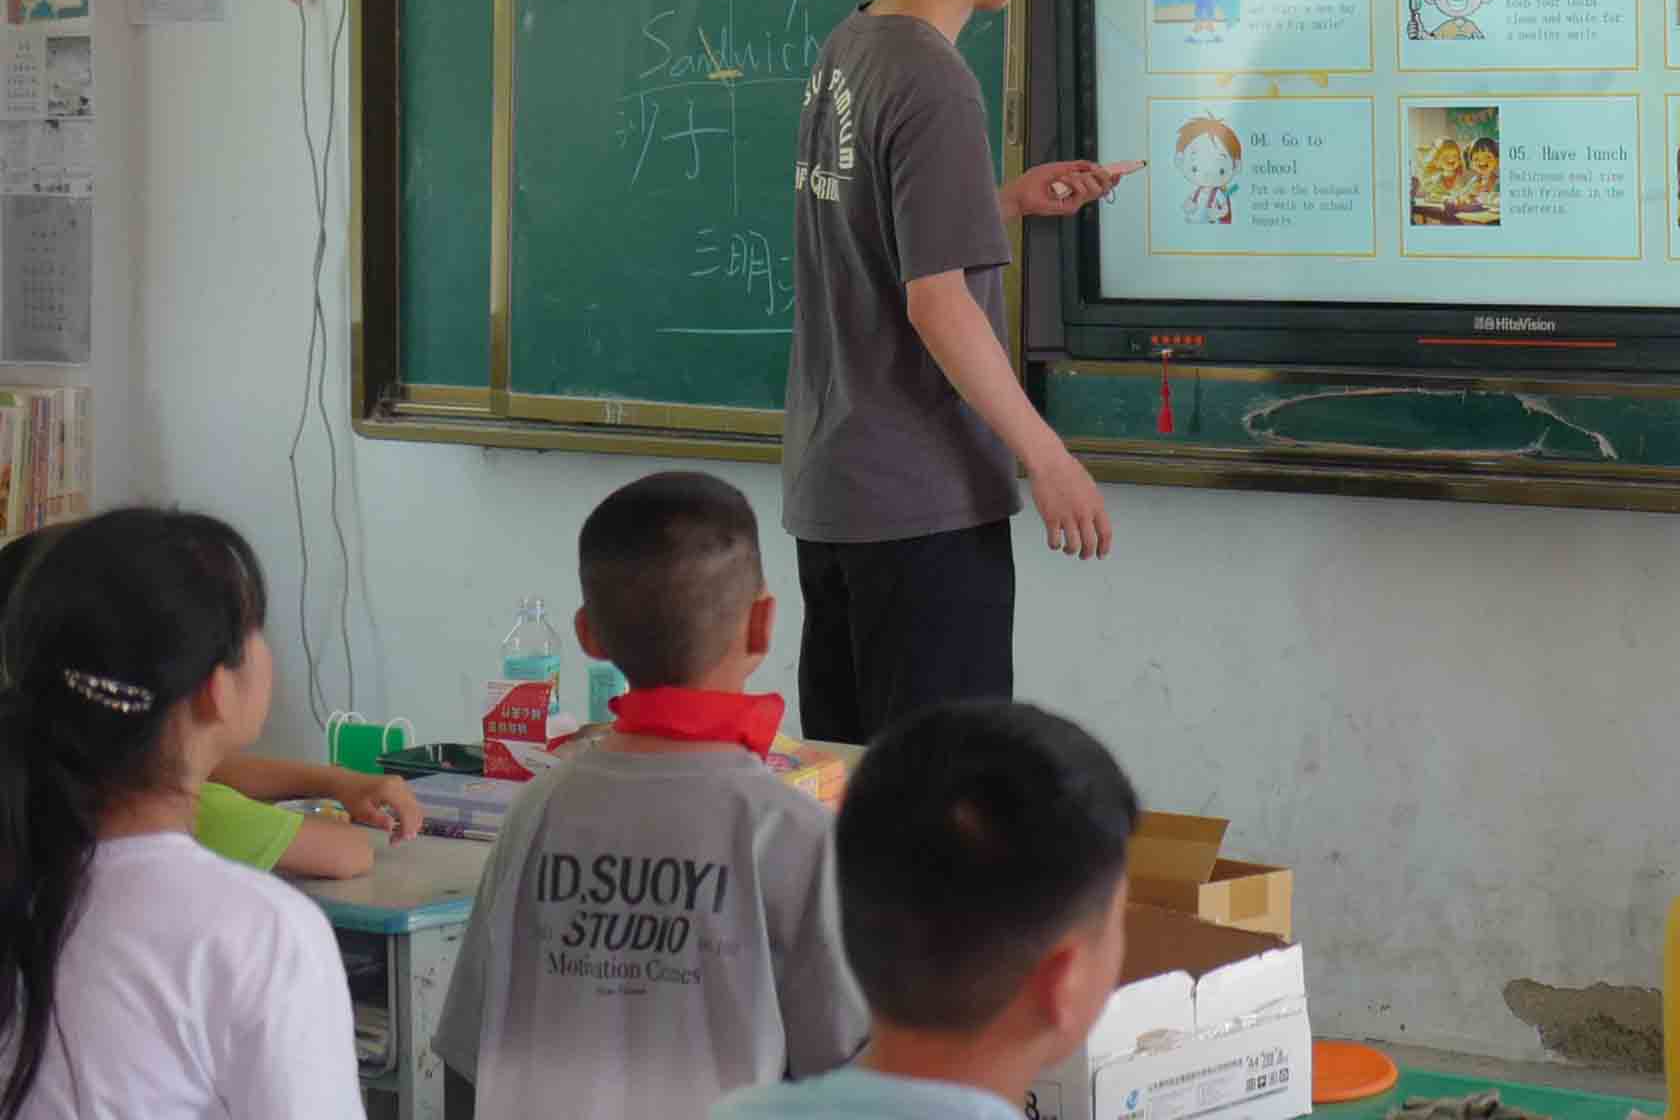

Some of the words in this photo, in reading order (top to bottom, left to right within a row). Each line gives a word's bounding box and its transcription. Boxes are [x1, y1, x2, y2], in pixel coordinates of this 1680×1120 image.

[1541, 144, 1577, 161] Have
[1585, 143, 1628, 161] lunch
[1251, 159, 1297, 176] school
[561, 910, 690, 955] STUDIO
